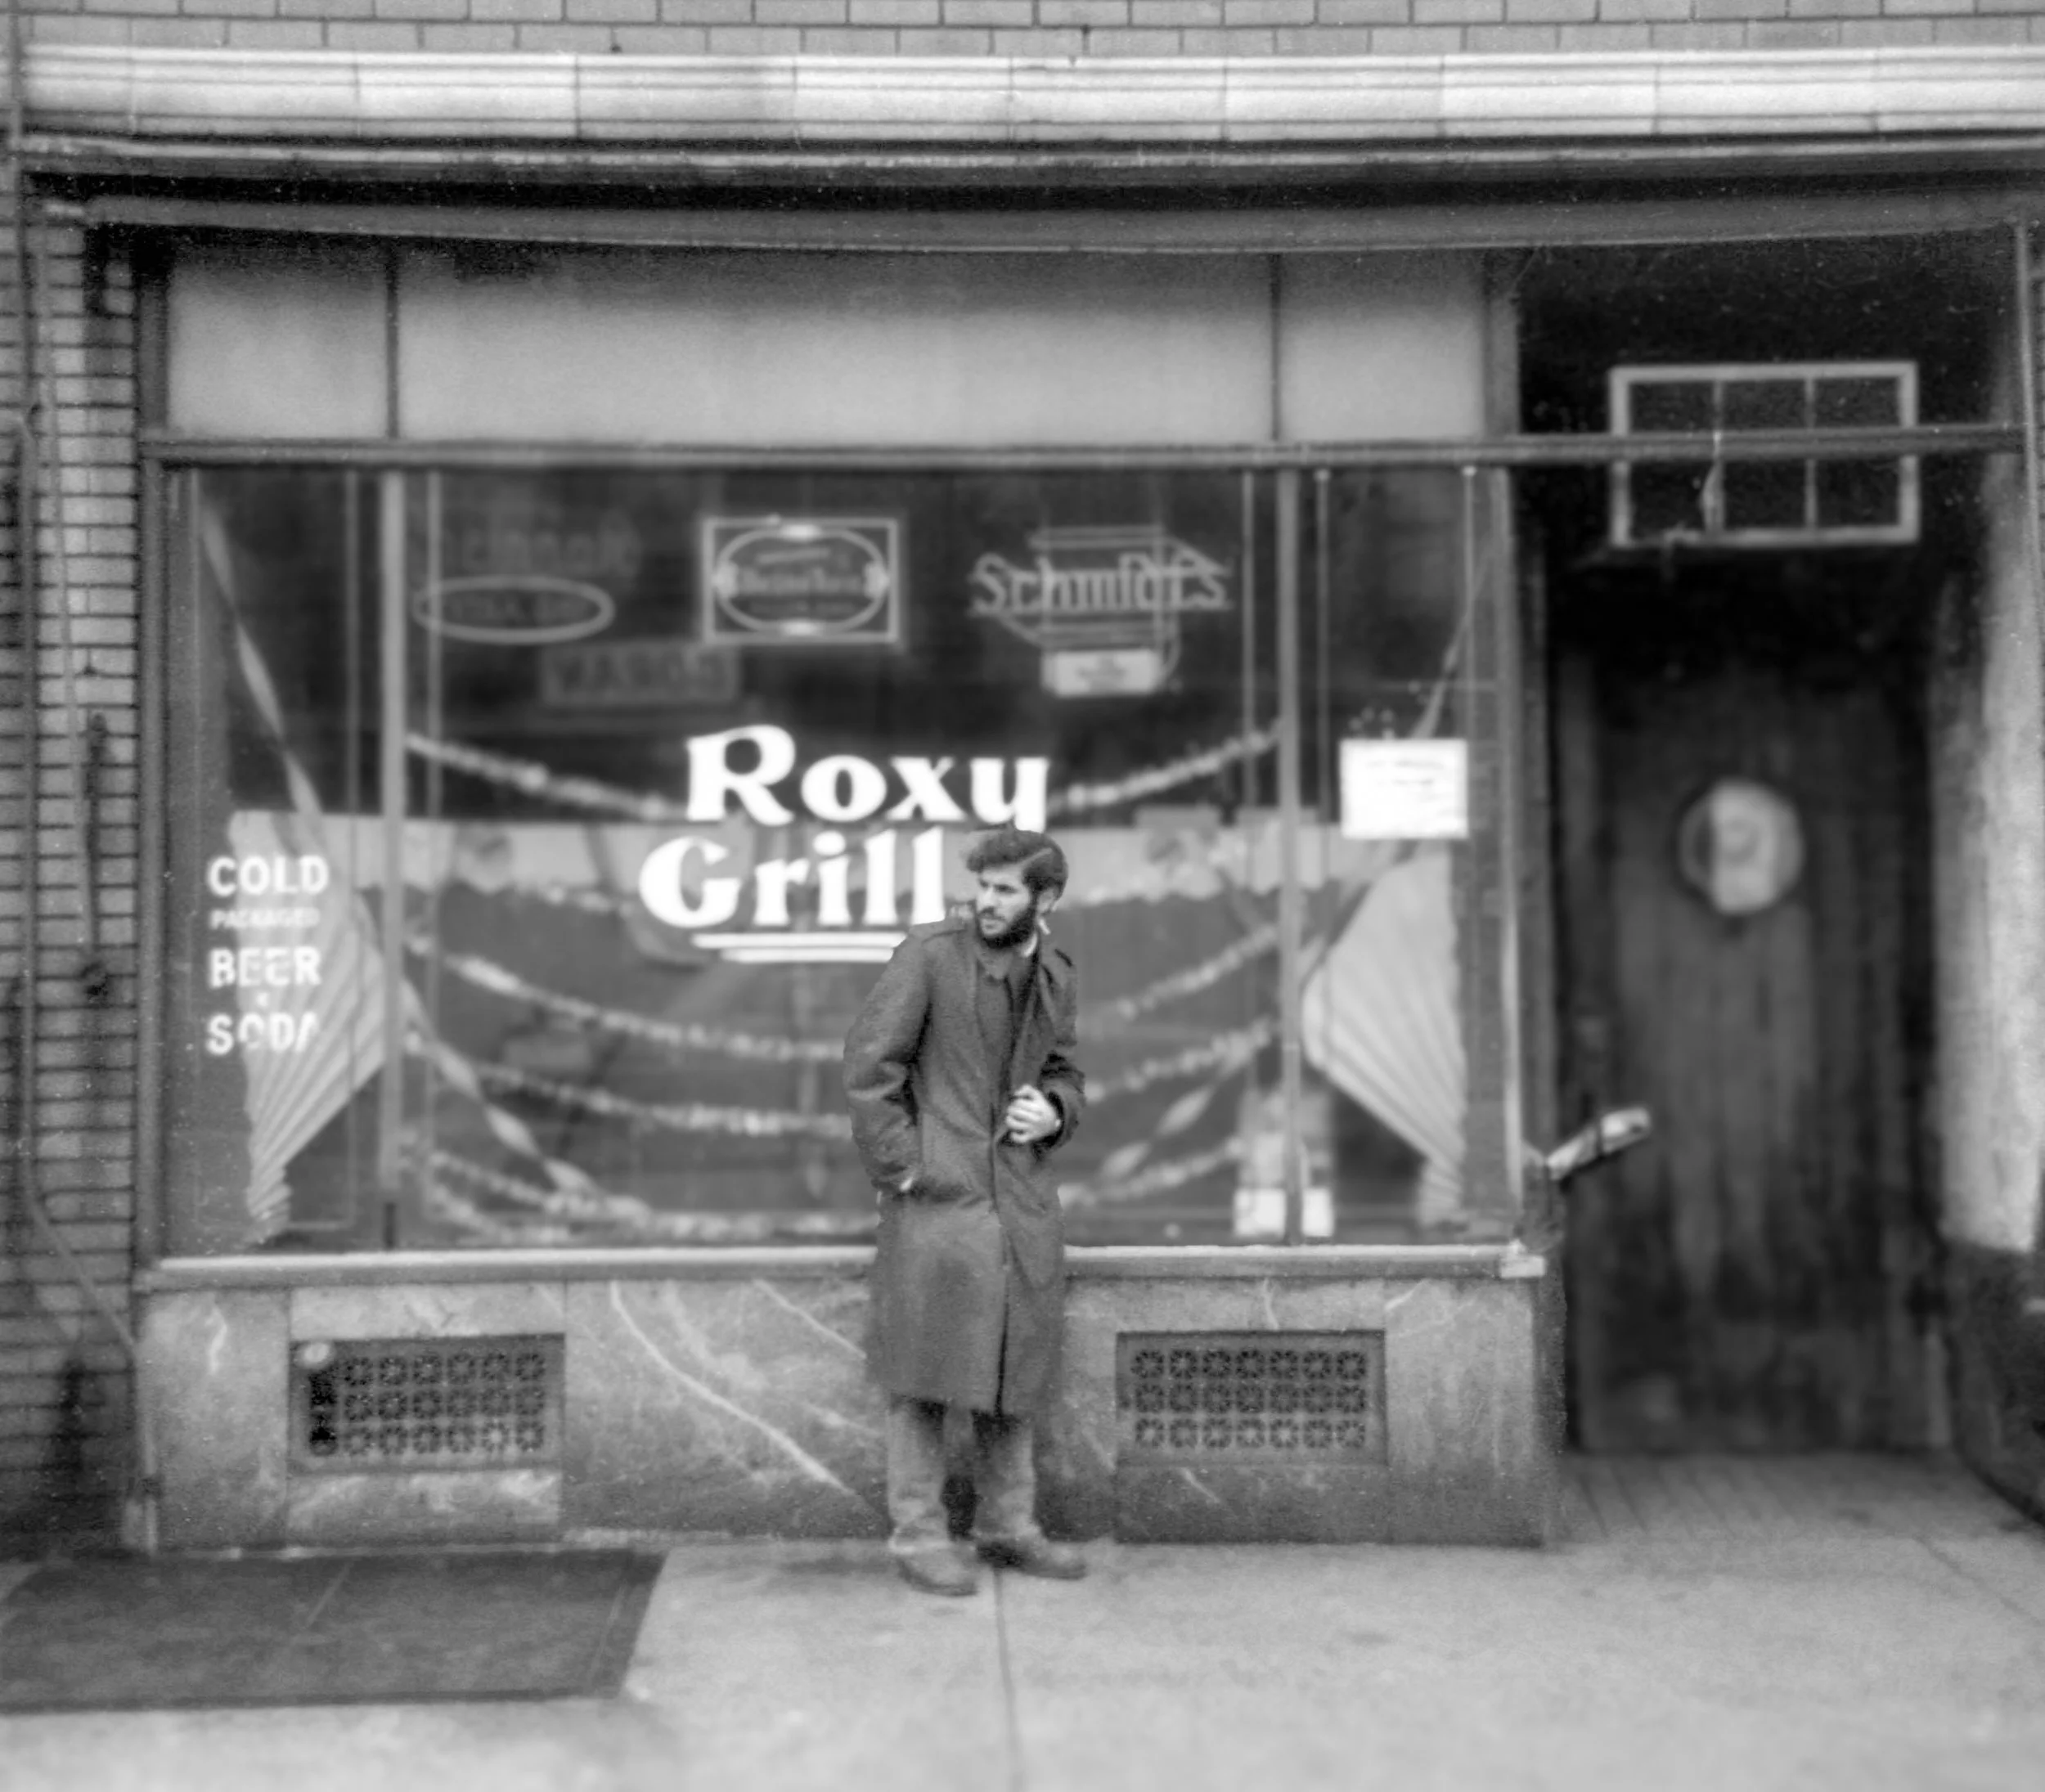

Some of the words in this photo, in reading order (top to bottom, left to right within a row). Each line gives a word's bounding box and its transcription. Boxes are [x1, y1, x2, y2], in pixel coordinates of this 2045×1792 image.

[685, 724, 1049, 832] Roxy
[208, 855, 329, 896] COLD
[638, 827, 947, 928] Grill
[209, 945, 322, 989] BEER
